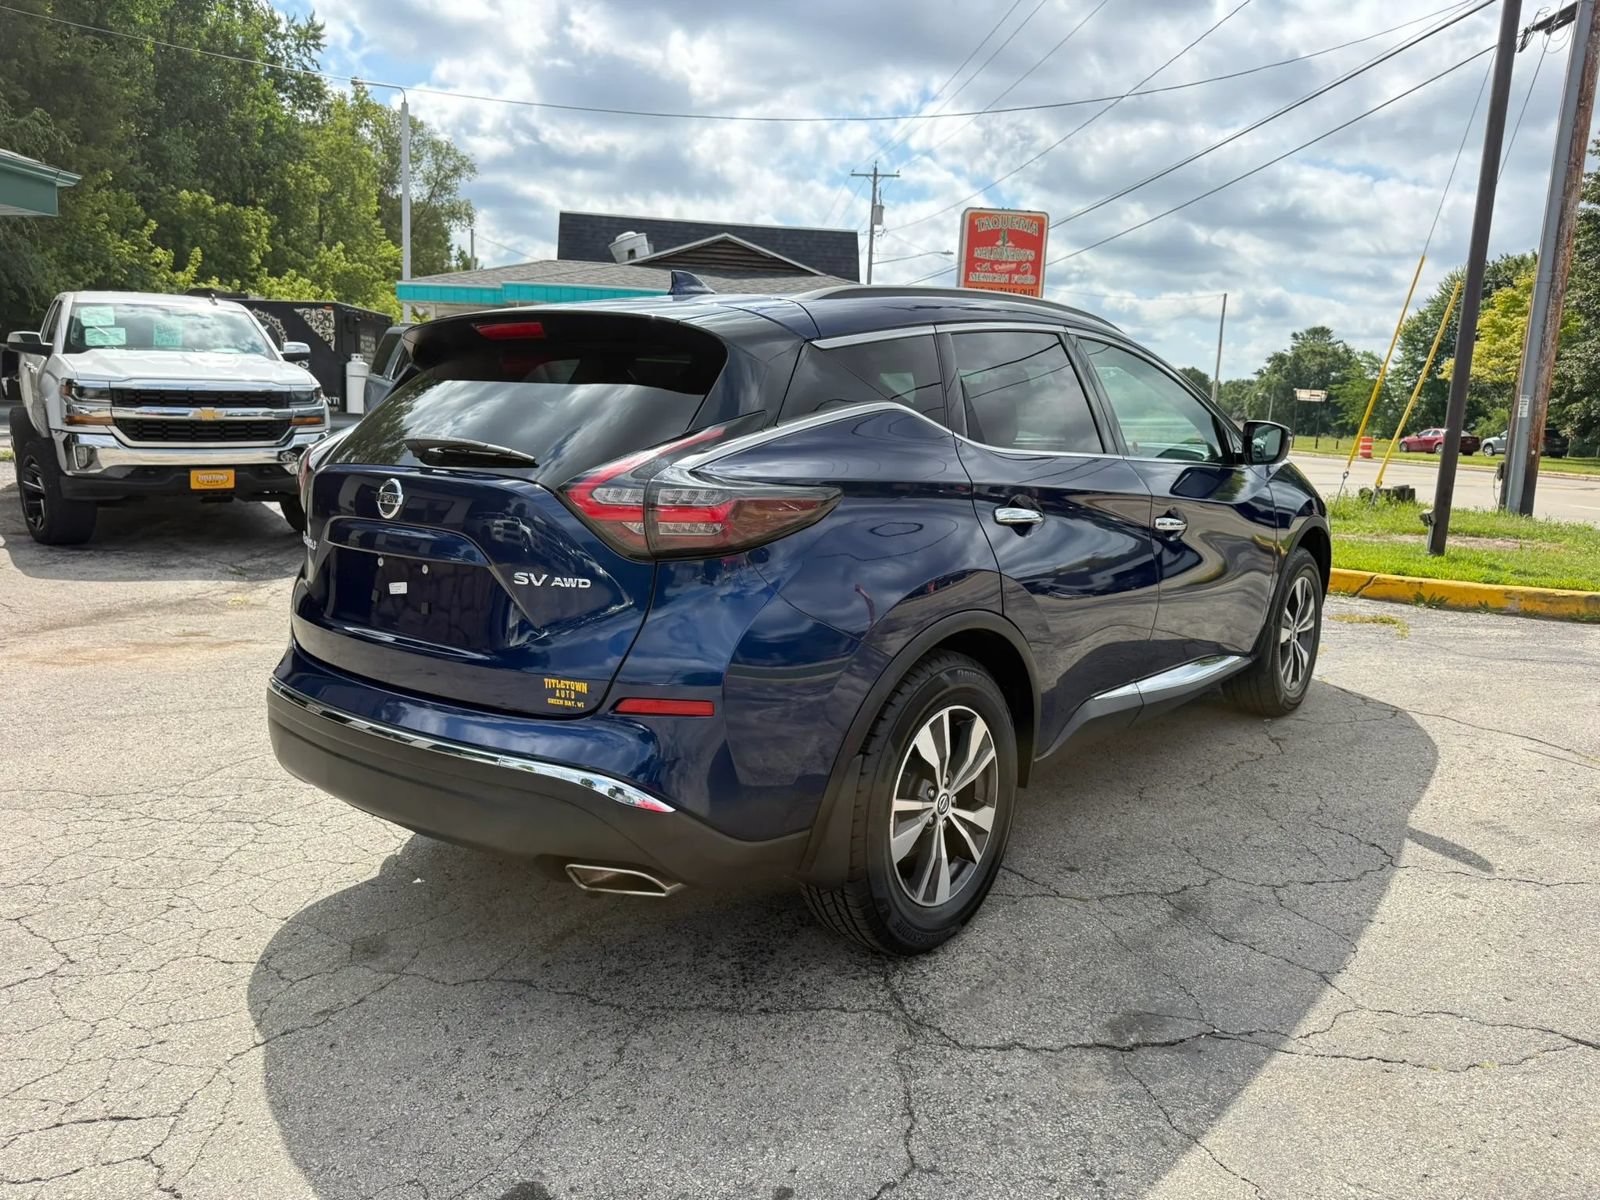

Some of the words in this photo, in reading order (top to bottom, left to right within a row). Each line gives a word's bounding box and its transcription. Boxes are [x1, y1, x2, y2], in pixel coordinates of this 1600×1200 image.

[975, 214, 1039, 236] TAQUERIA
[514, 572, 548, 587] SV
[551, 577, 591, 588] AWD
[544, 678, 588, 694] TITLETOWN
[555, 689, 575, 699] AUTO
